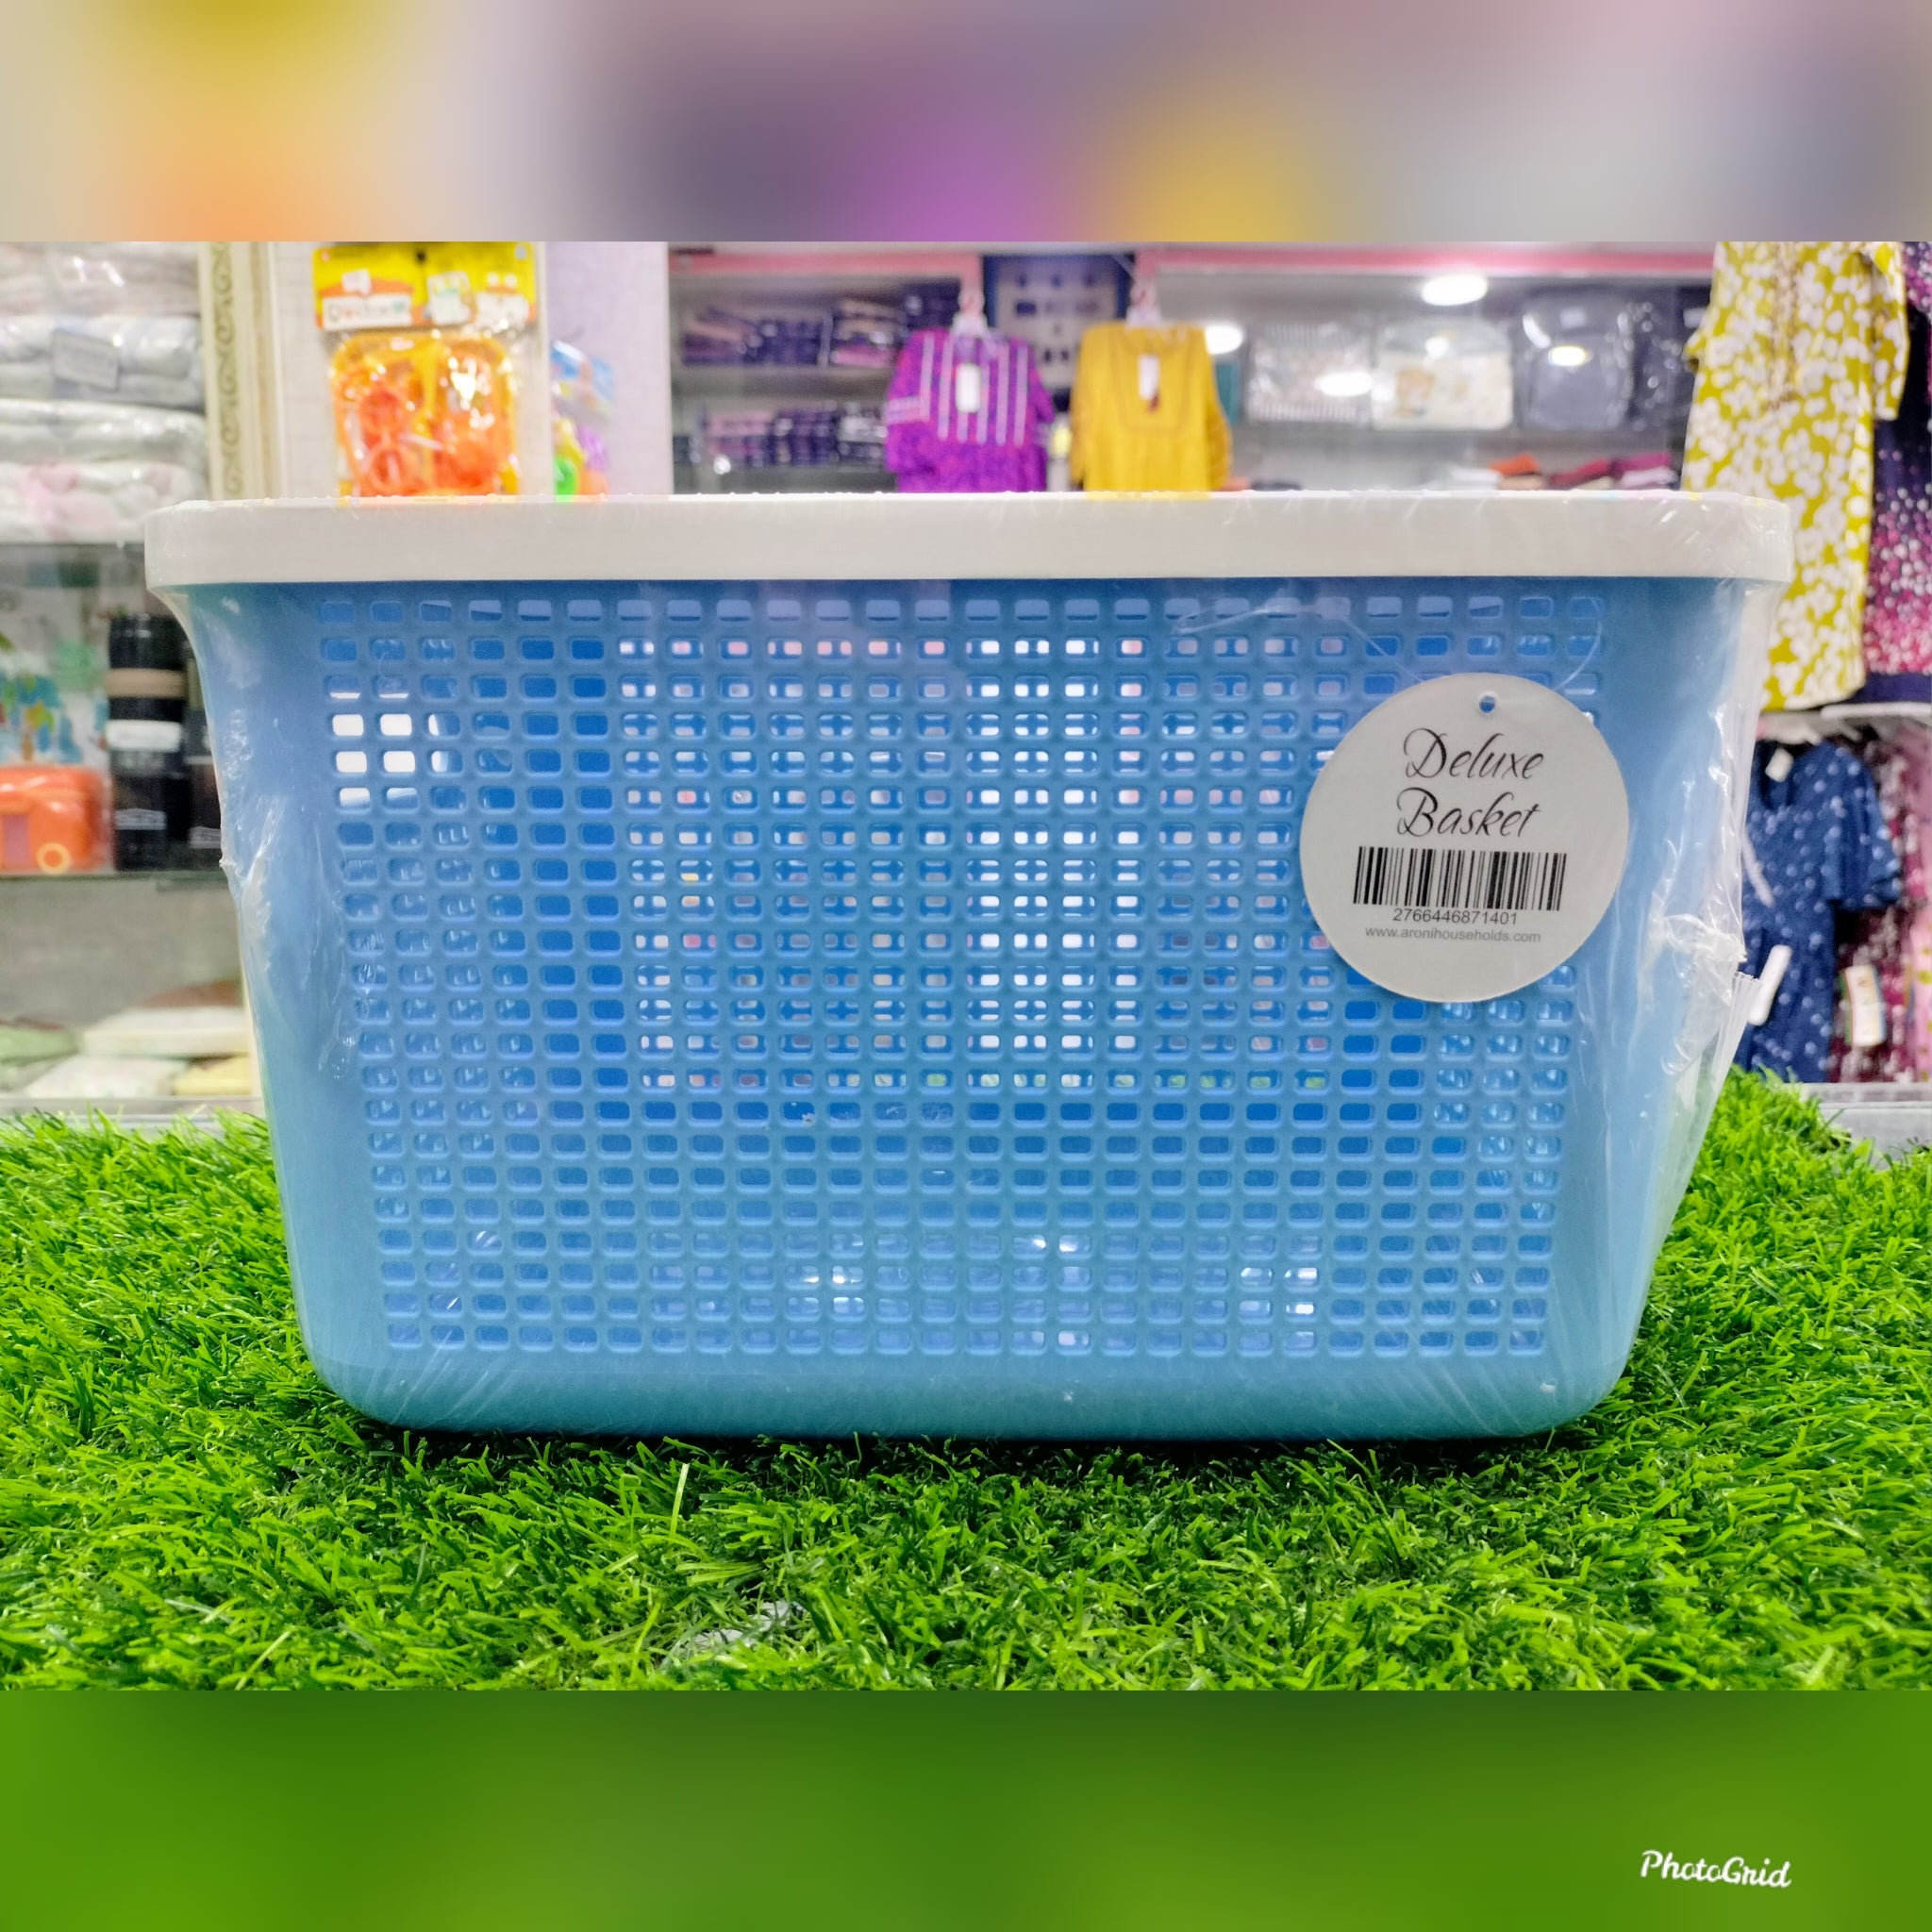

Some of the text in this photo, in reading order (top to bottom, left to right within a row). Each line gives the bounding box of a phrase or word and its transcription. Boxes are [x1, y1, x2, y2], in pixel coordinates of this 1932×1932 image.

[1403, 727, 1544, 780] Deluxe
[1396, 787, 1541, 839] Basket
[1392, 907, 1518, 925] 2766446871401
[1364, 926, 1541, 943] www.aronihouseholds.com
